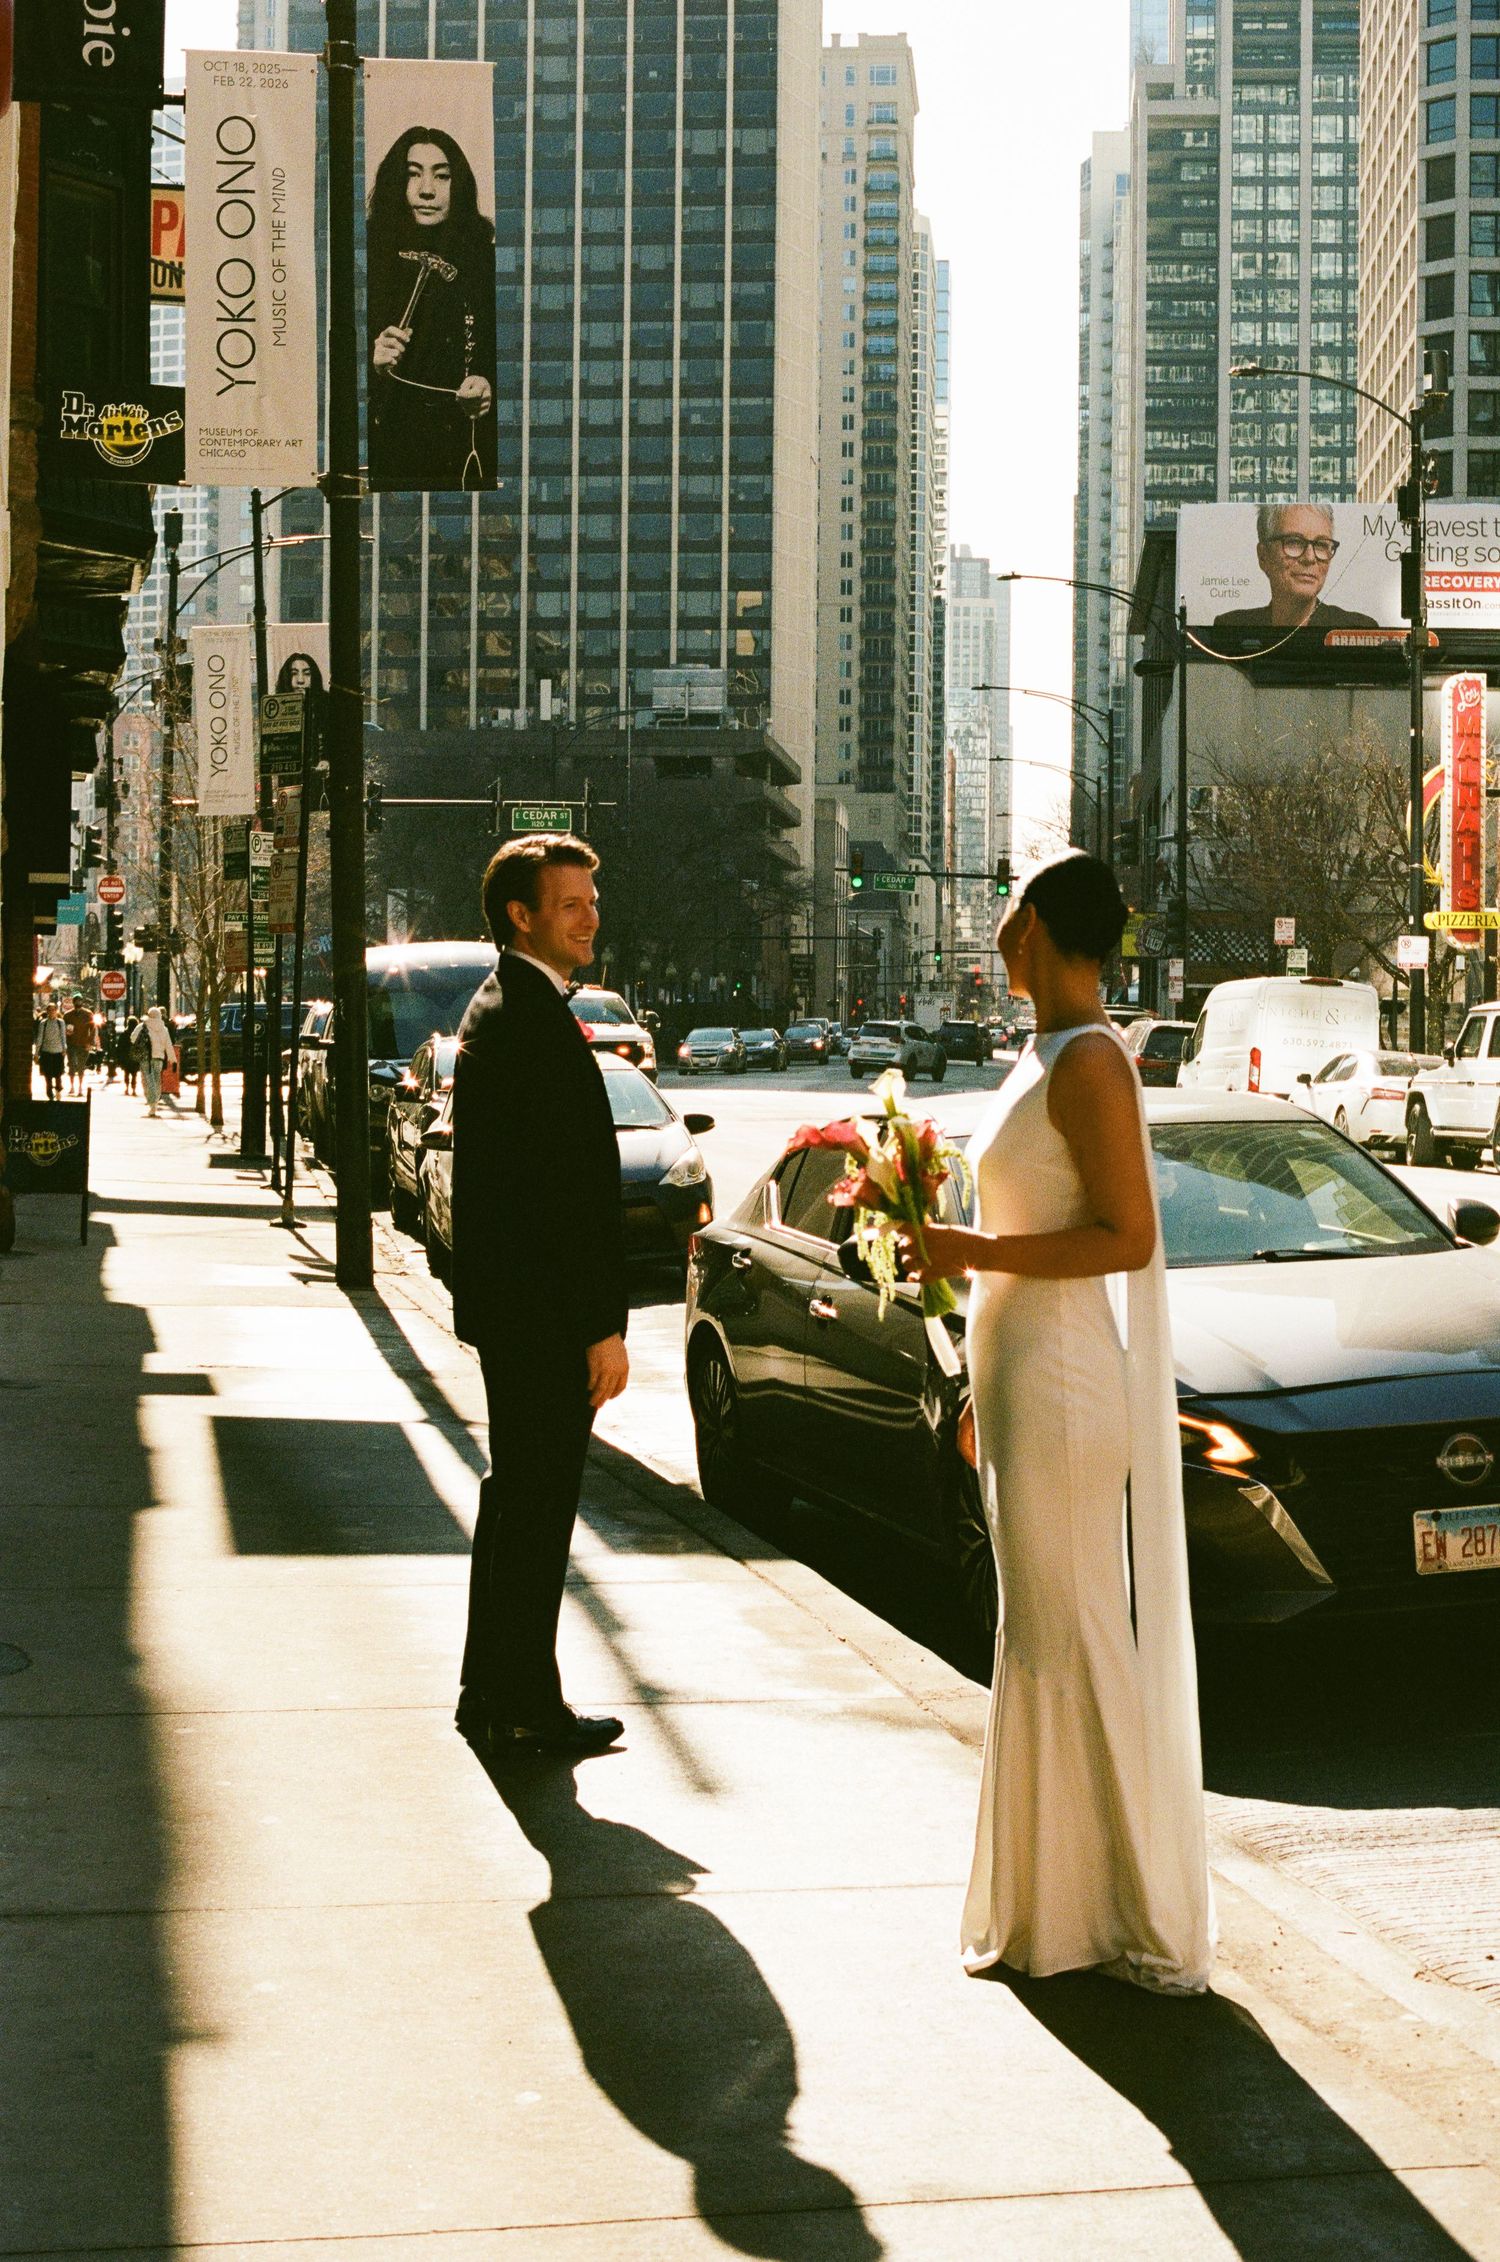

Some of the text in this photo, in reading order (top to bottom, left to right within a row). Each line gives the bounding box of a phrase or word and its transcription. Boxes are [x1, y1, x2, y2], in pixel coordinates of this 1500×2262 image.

[203, 60, 229, 72] OCT
[232, 61, 249, 74] 18,
[213, 75, 289, 89] FEB 22, 2026
[151, 199, 186, 257] P
[216, 115, 257, 397] YOKO ONO
[272, 167, 288, 347] MUSIC OF THE MIND
[98, 402, 150, 422] AirWair
[60, 410, 184, 440] Martens
[199, 427, 260, 437] MUSEUM OF
[198, 437, 303, 448] CONTEMPORARY ART
[198, 448, 247, 458] CHICAGO
[1363, 514, 1396, 541] My
[1384, 540, 1469, 568] Gting
[1200, 575, 1250, 586] Jamie Lee
[1209, 587, 1241, 598] Curtis
[207, 654, 226, 710] ONO
[210, 716, 228, 778] YOKO
[522, 811, 558, 820] CEDAR
[881, 876, 907, 884] CEDAR
[1438, 914, 1499, 927] PIZZERIA
[1268, 1007, 1319, 1021] NICHE
[1325, 1007, 1340, 1025] &
[9, 1134, 79, 1152] Martens
[1436, 1454, 1494, 1469] NISSAN
[1460, 1523, 1500, 1558] 287
